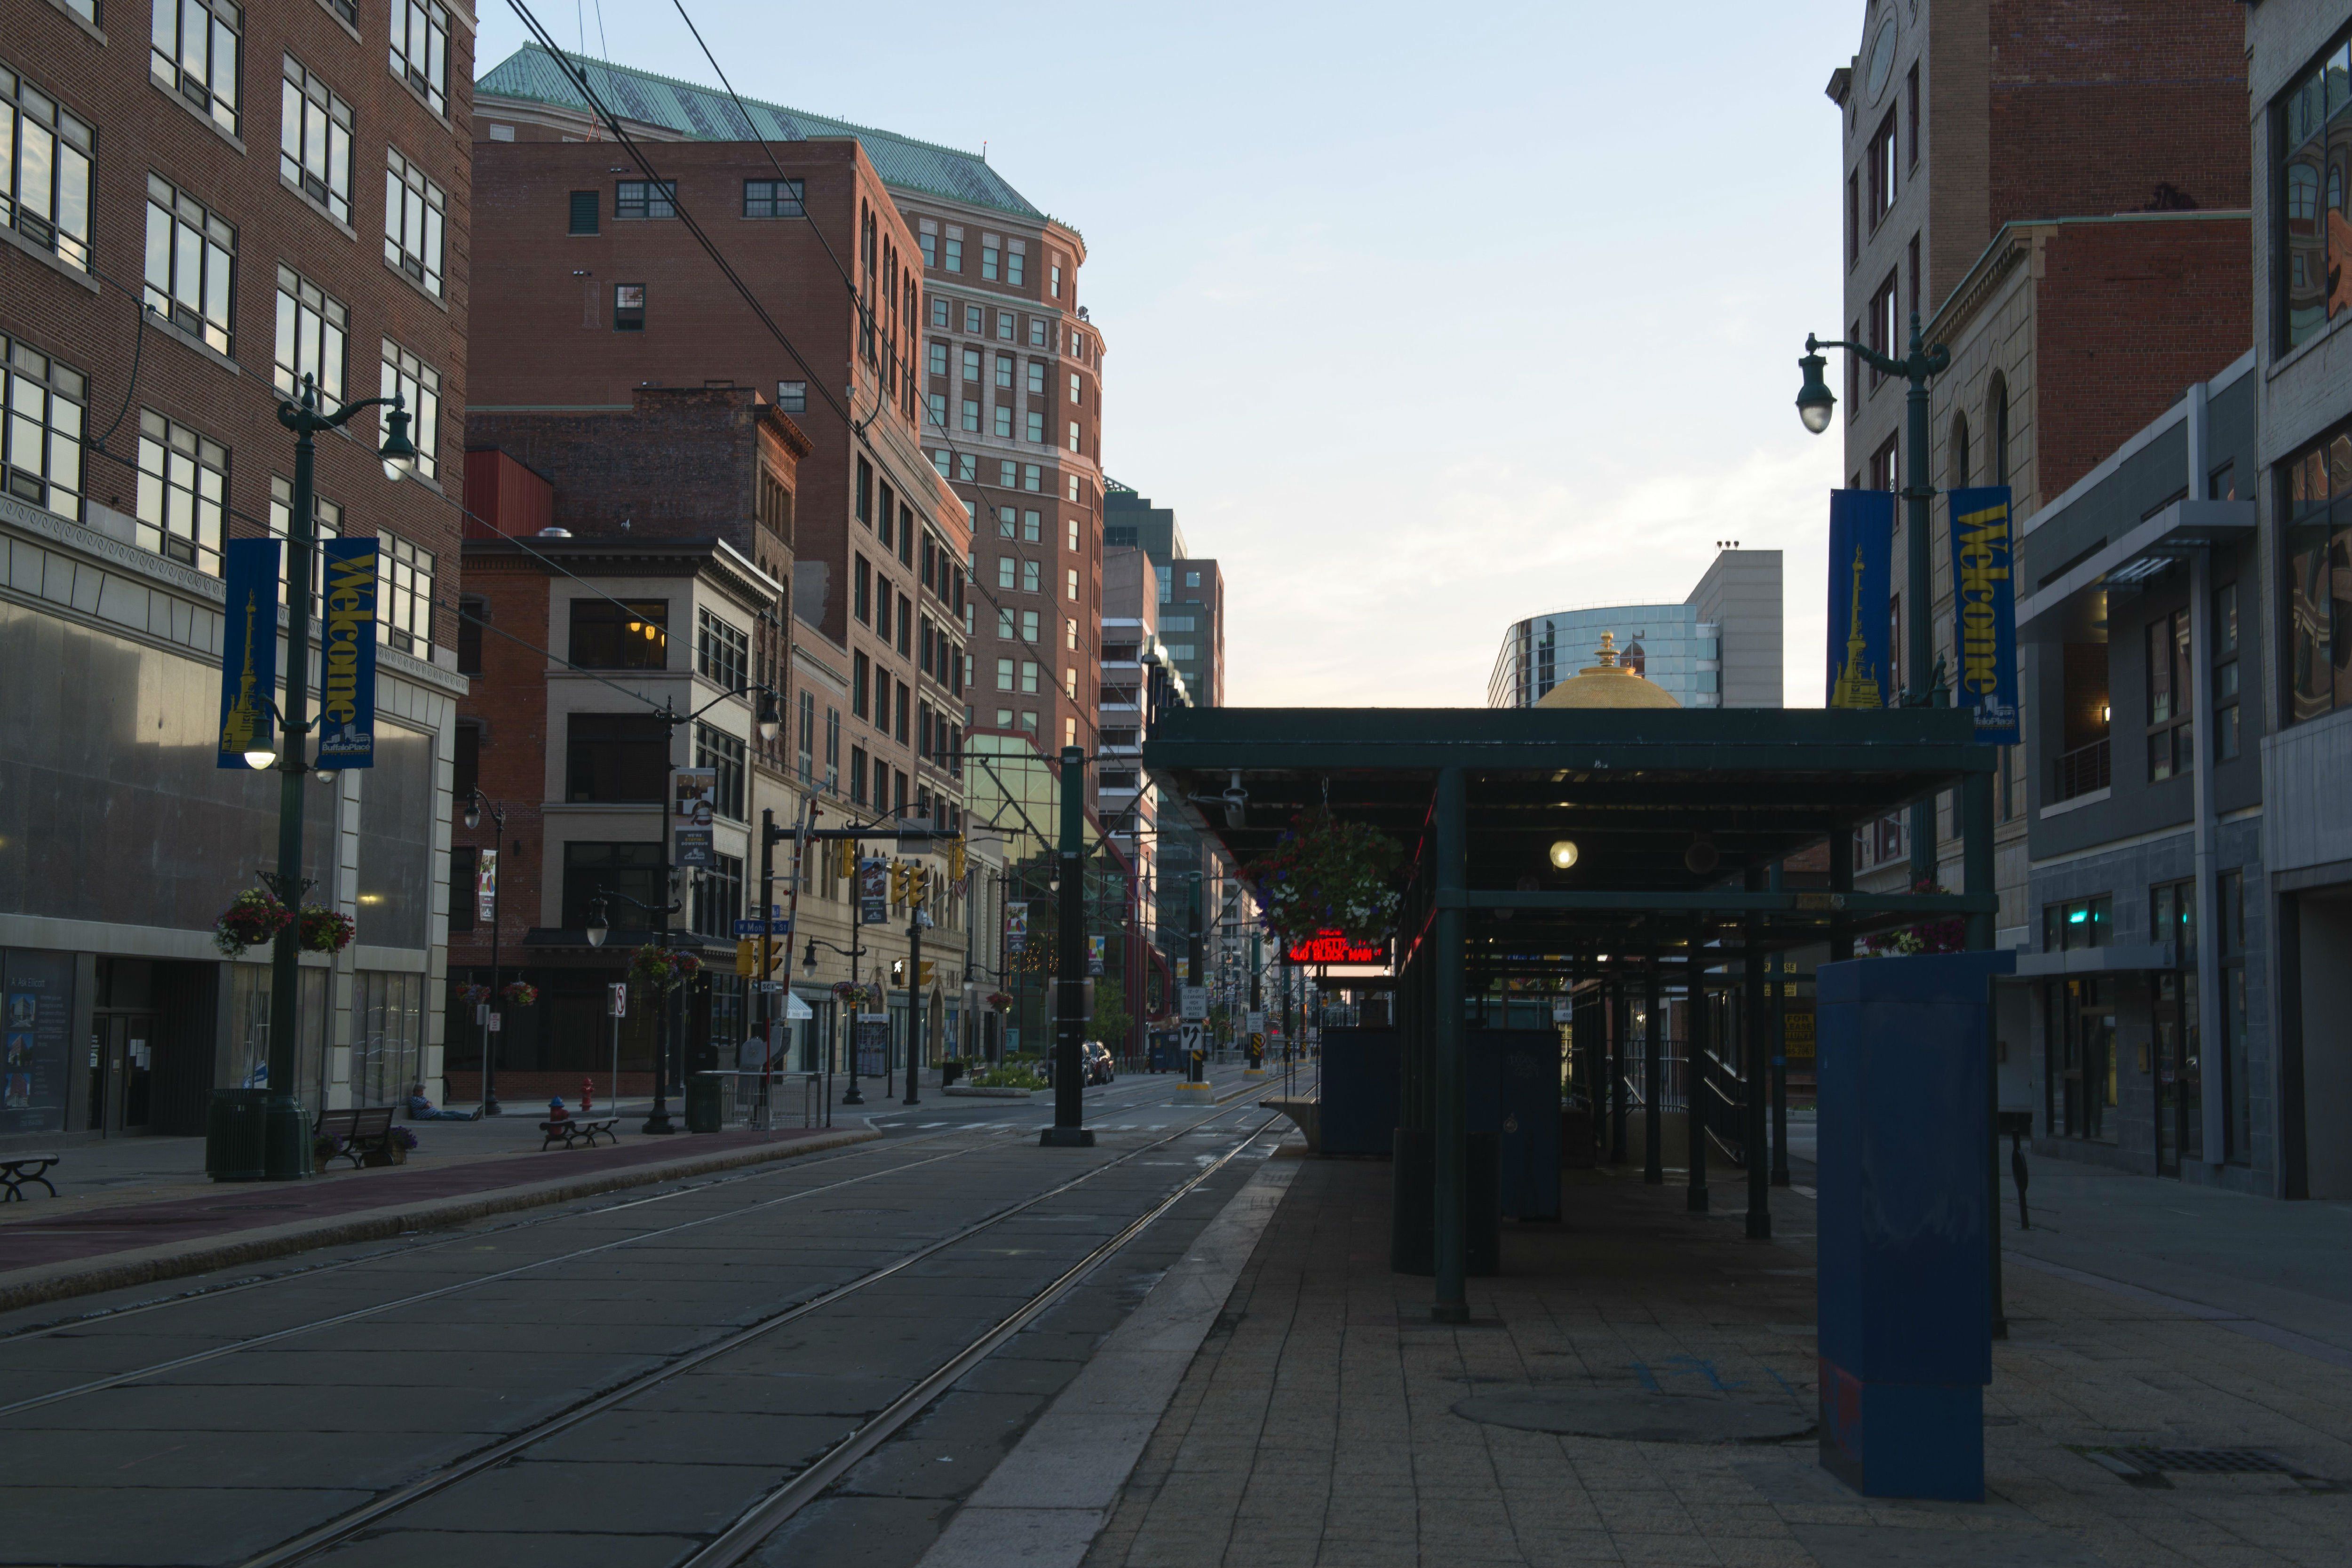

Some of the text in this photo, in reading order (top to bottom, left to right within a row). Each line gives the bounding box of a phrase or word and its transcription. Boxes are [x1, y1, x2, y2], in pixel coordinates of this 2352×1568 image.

[1958, 502, 2008, 694] Welcome
[326, 551, 376, 724] Welcome
[322, 742, 371, 751] BuffaloPlace
[1313, 948, 1345, 961] BLOCK
[1348, 948, 1372, 961] MAIN
[18, 978, 27, 987] Ask
